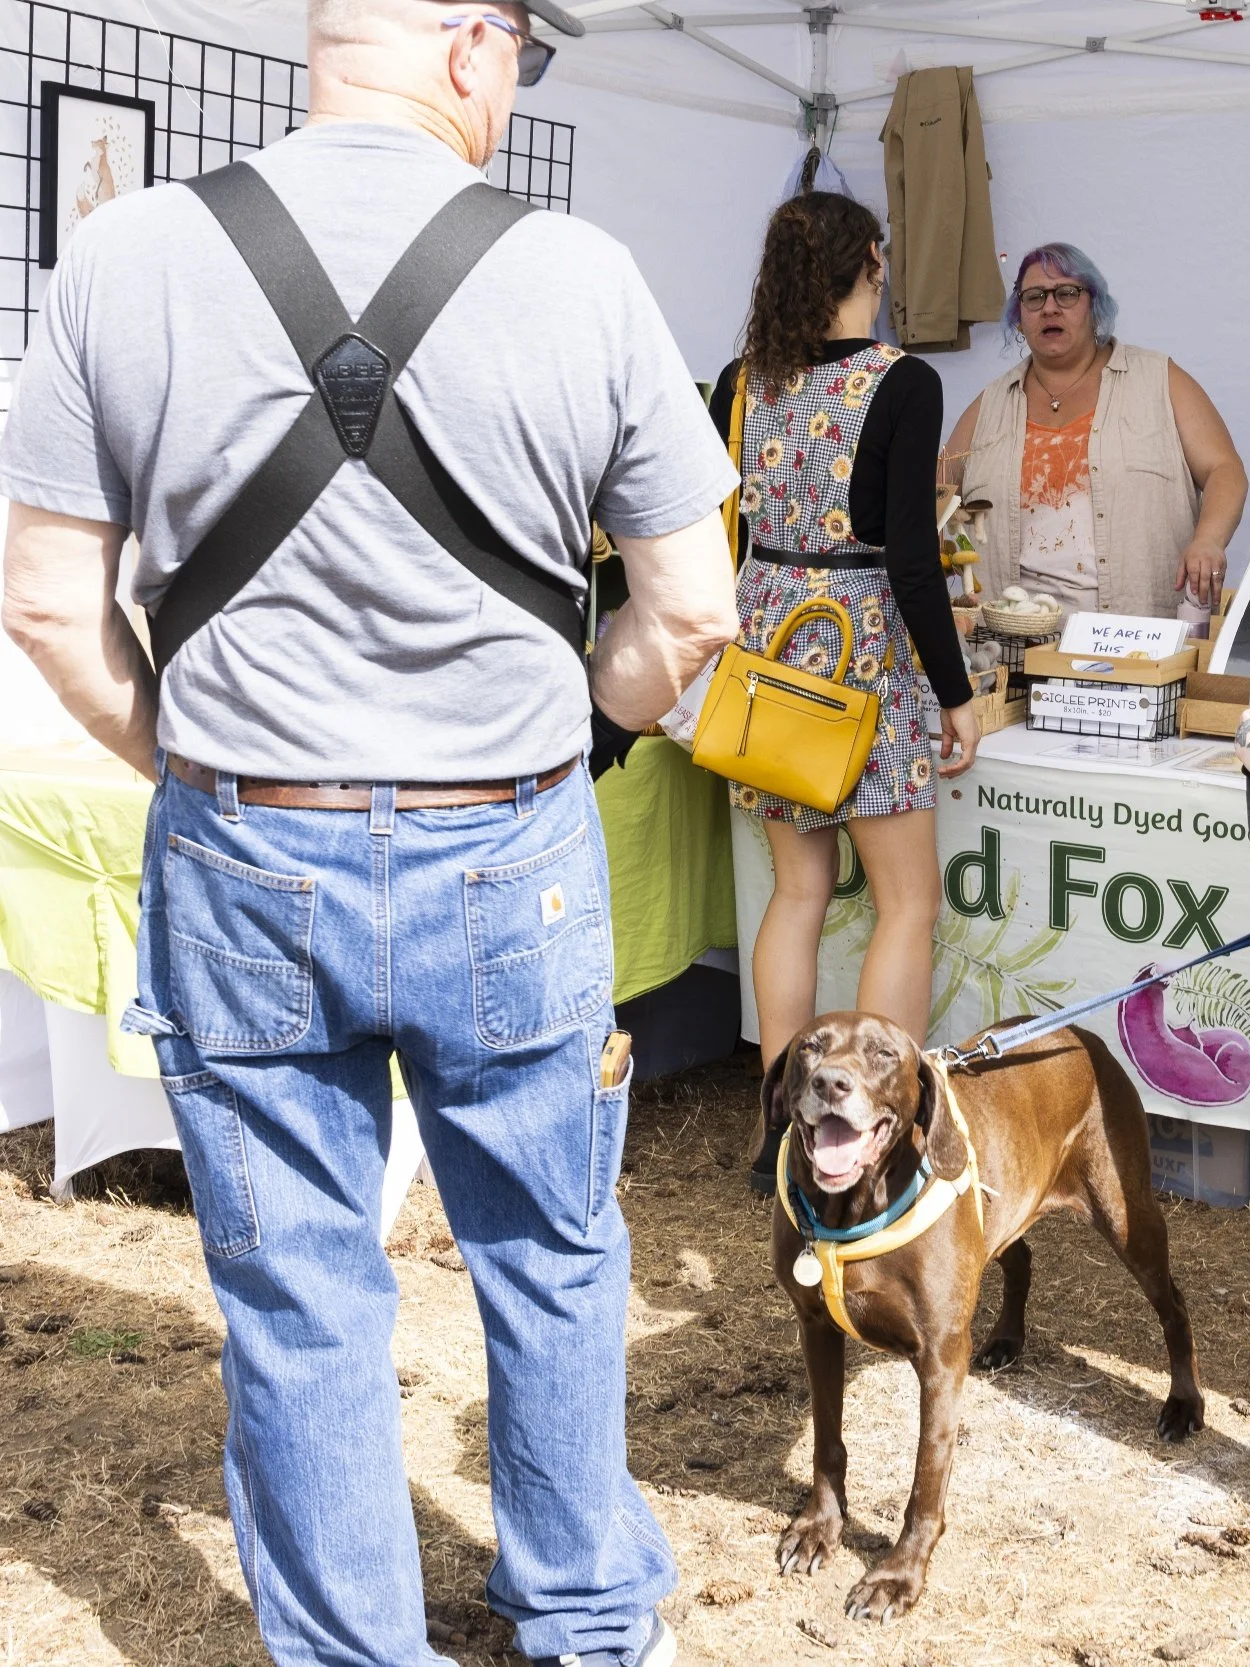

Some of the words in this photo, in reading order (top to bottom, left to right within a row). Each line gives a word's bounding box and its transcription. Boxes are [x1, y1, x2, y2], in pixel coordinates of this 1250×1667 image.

[1092, 626, 1112, 637] WE
[1114, 628, 1142, 640] ARE
[1146, 632, 1162, 640] IN
[1093, 641, 1124, 653] THIS
[1041, 692, 1086, 706] GICLEE
[1087, 697, 1137, 710] PRINTS
[977, 784, 1104, 829] Naturally
[1112, 801, 1183, 836] Dyed
[1049, 840, 1231, 957] Fox
